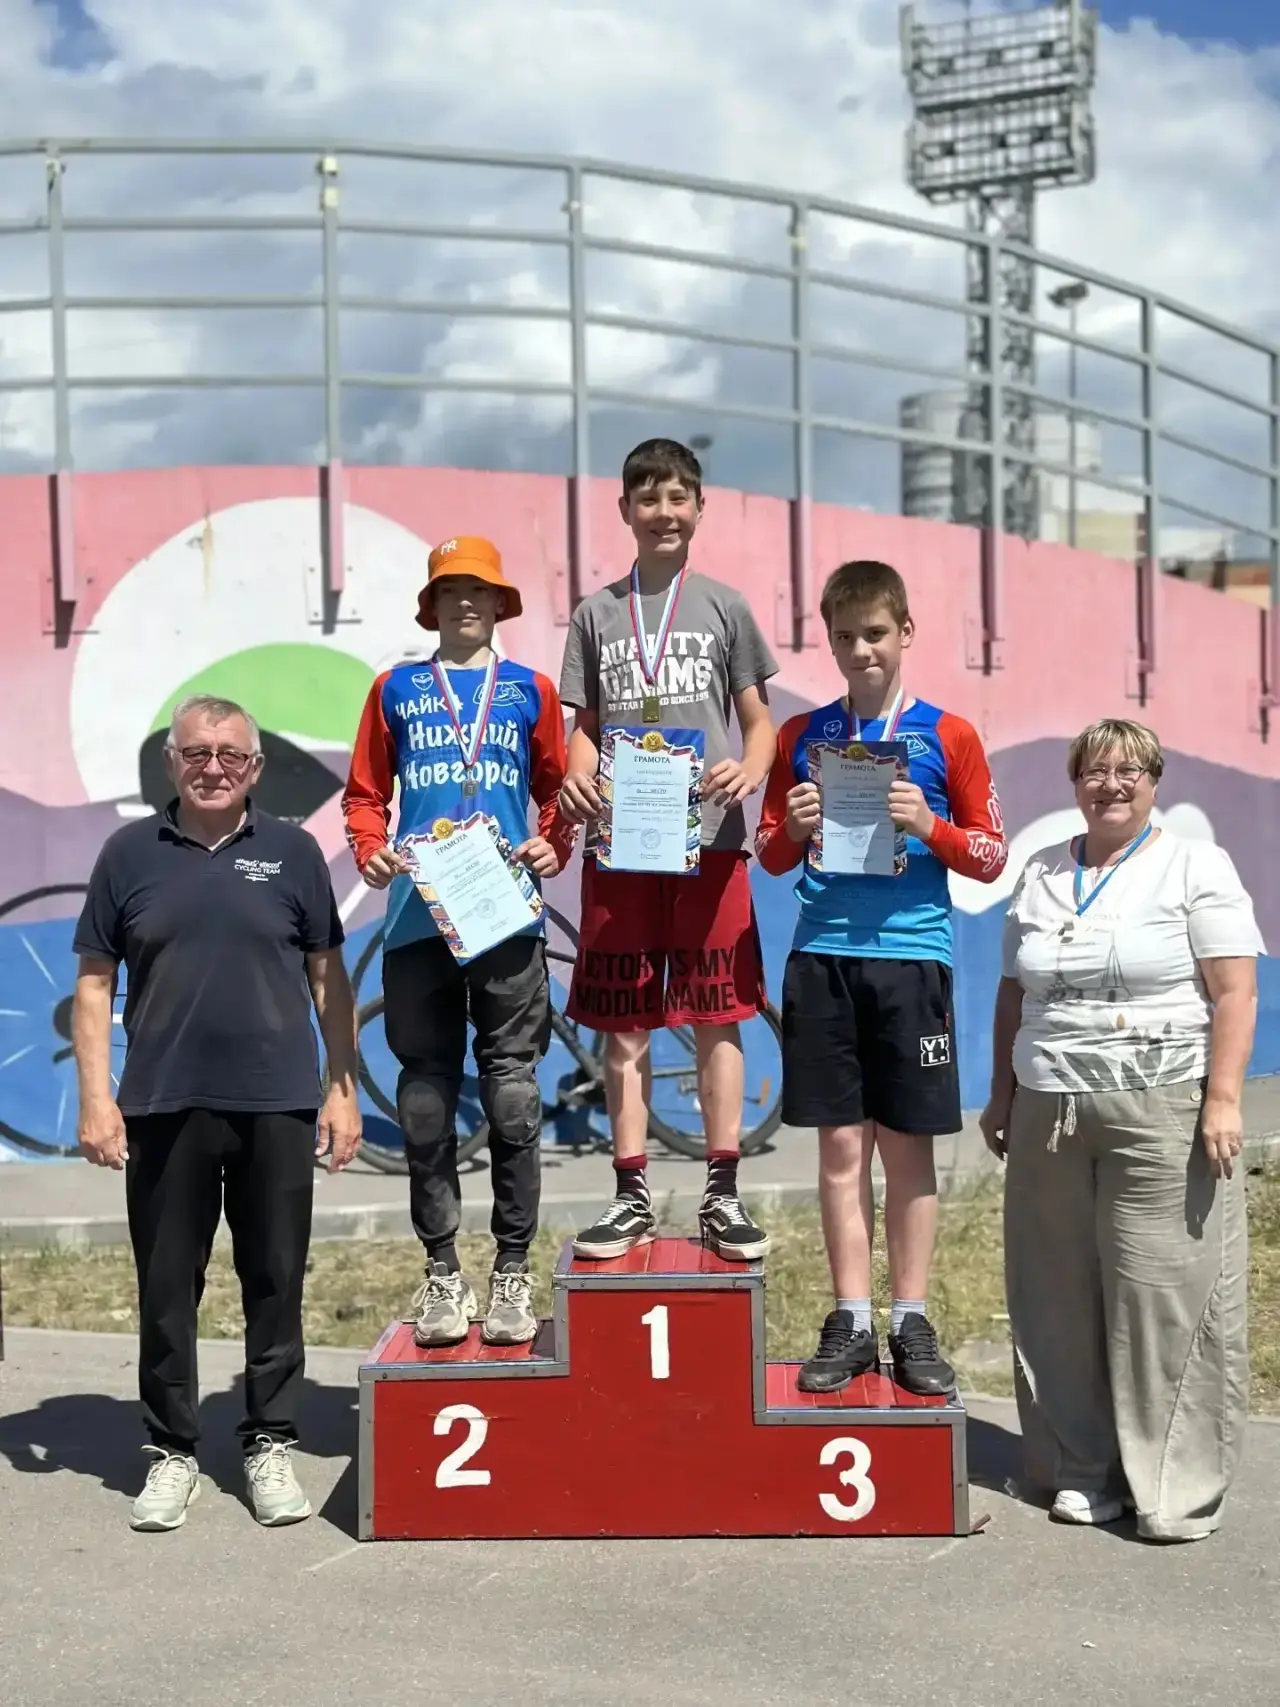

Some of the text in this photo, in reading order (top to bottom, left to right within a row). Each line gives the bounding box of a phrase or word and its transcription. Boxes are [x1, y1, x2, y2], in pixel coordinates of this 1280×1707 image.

[670, 694, 694, 705] SINCE
[633, 755, 671, 764] ГРАМОТА
[840, 763, 876, 772] ГРАМОТА
[435, 833, 468, 856] ГРАМОТА
[234, 864, 261, 873] CYCLING
[698, 947, 735, 977] MY
[665, 982, 736, 1013] NAME
[641, 1304, 670, 1379] 1
[433, 1404, 491, 1489] 2
[818, 1436, 876, 1522] 3
